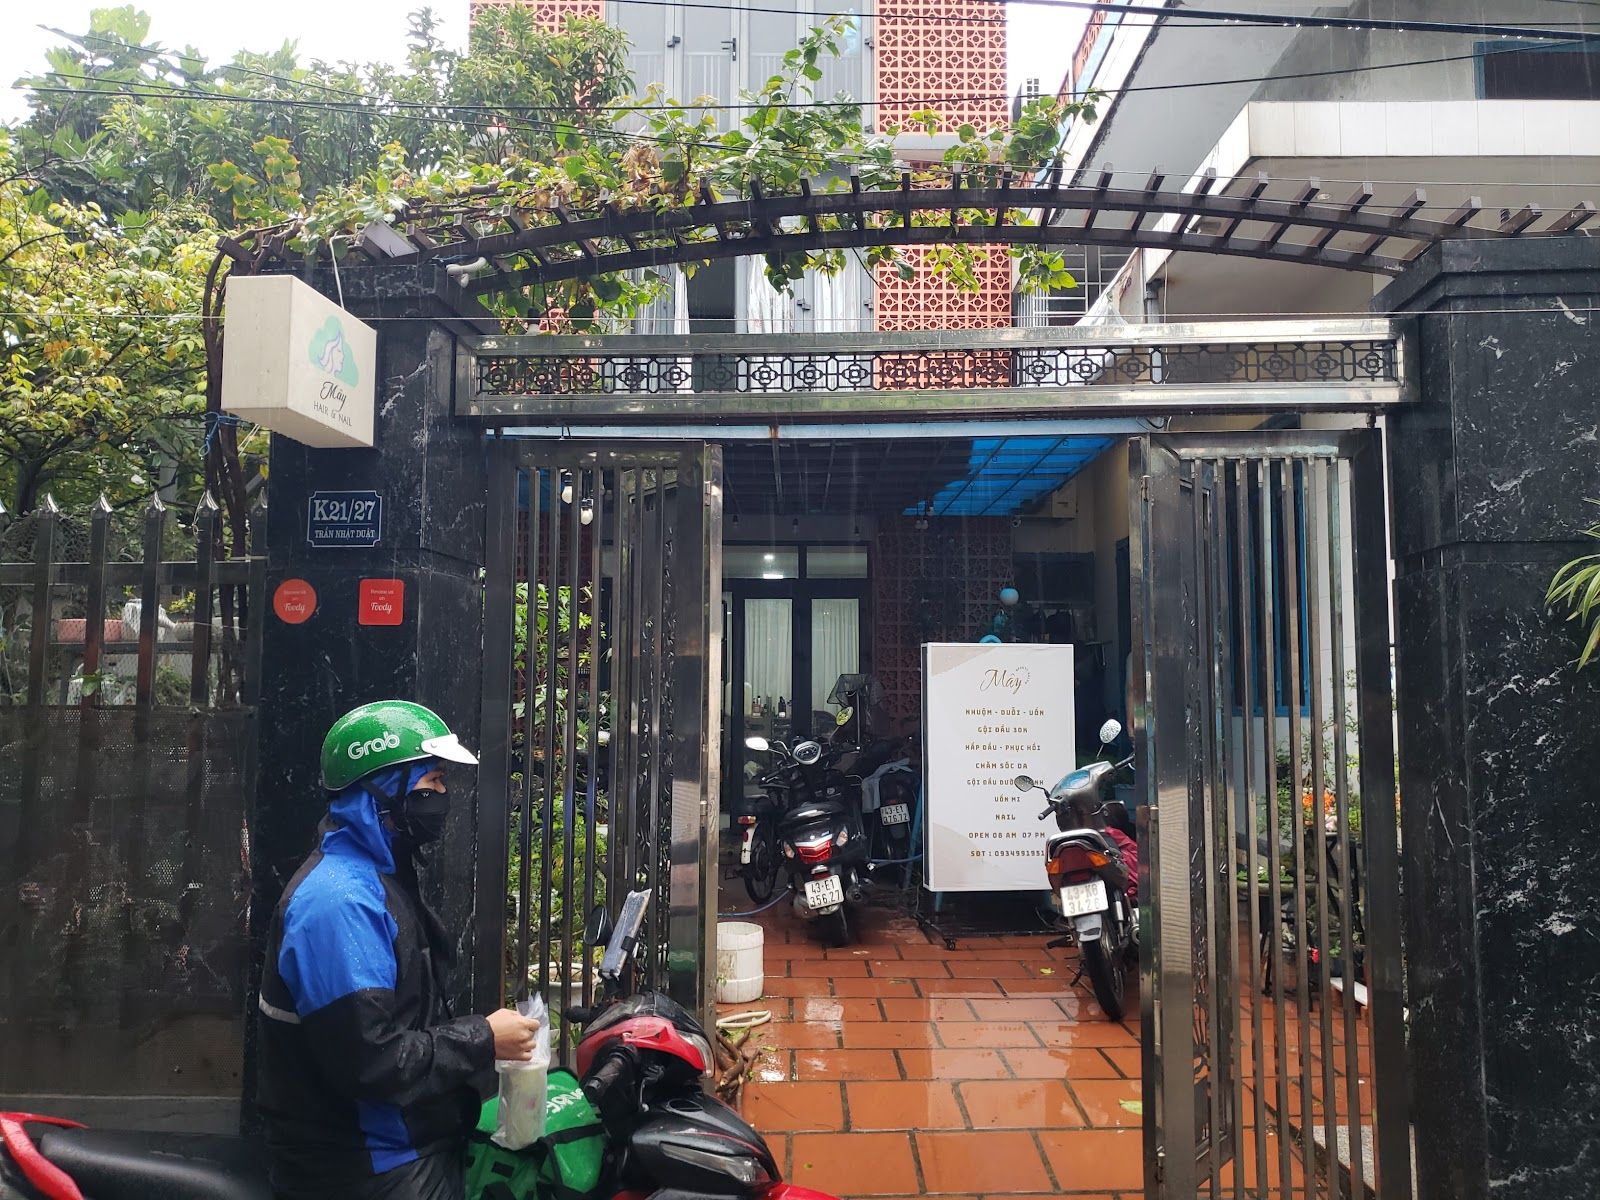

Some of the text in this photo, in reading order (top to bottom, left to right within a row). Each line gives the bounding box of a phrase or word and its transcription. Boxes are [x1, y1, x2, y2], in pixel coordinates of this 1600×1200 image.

[313, 400, 329, 416] HAIR
[338, 413, 352, 427] NAIL
[313, 498, 376, 523] K21/27
[335, 527, 355, 541] NHẬT
[356, 527, 375, 540] DUẬT
[283, 602, 305, 614] Foody
[370, 602, 392, 615] Foody
[980, 669, 1022, 694] Mây
[978, 725, 992, 735] GỘI
[348, 731, 400, 760] Grab
[995, 794, 1009, 802] UỐN
[811, 879, 835, 894] 43-E1
[810, 889, 840, 908] 356.27
